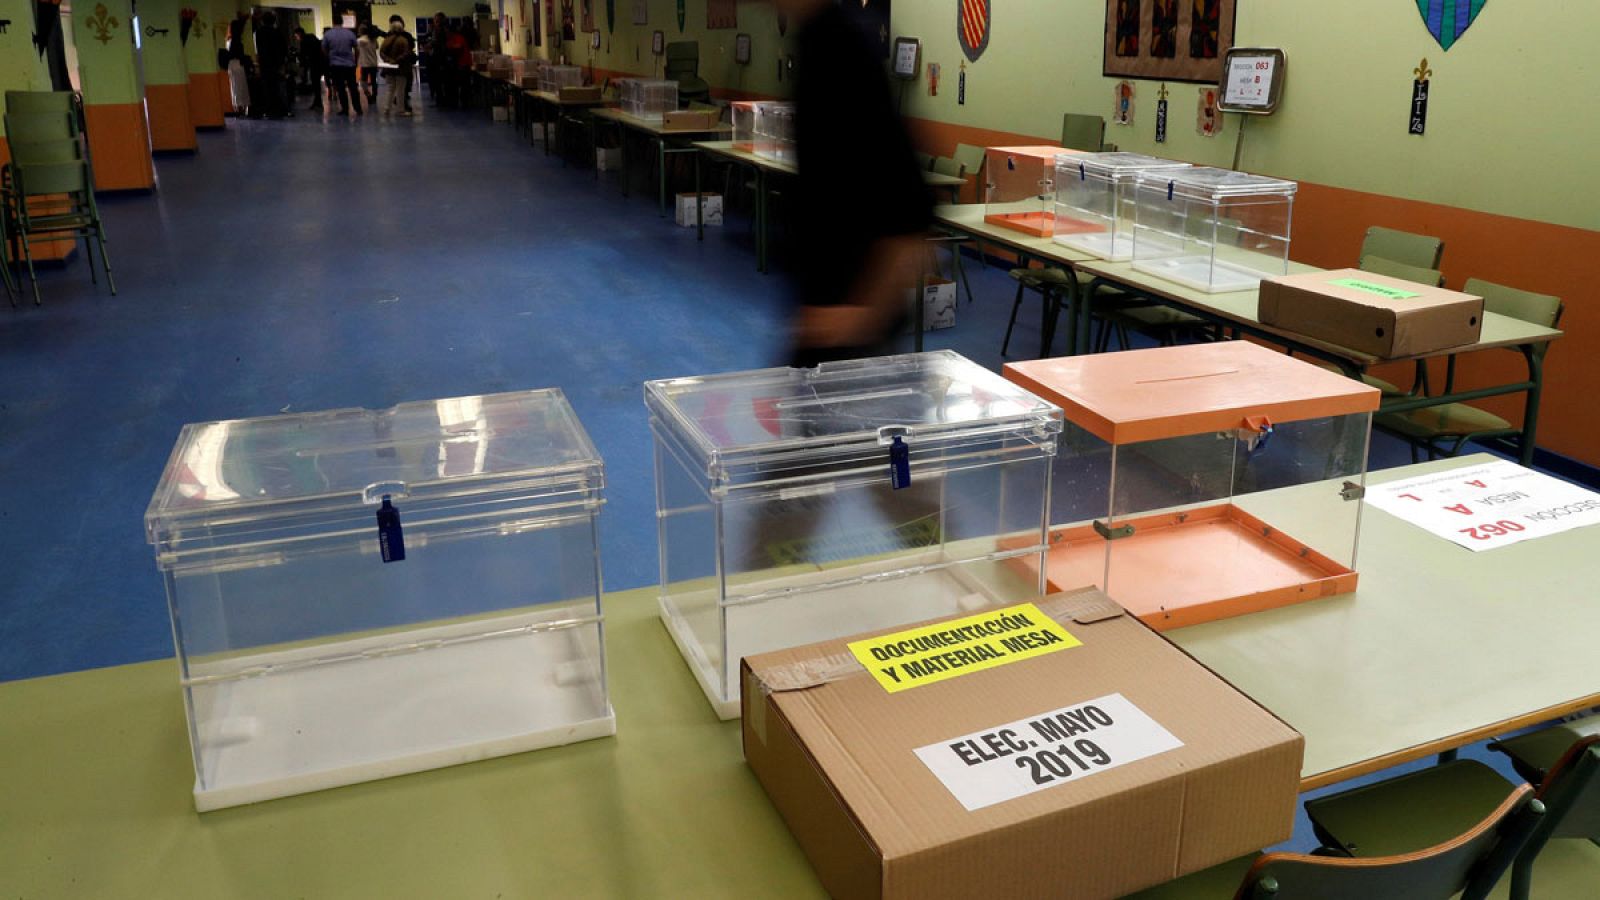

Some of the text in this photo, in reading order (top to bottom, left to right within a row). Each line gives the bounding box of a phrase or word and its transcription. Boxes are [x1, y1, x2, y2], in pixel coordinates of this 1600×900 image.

[1255, 62, 1269, 70] 063
[1254, 75, 1261, 84] B
[1463, 479, 1488, 489] A
[1397, 493, 1424, 502] L
[1442, 490, 1530, 516] MESA A
[1458, 519, 1526, 541] 062
[869, 612, 1035, 662] DOCUMENTACIÓN
[881, 628, 1064, 684] Y MATERIAL MESA
[949, 704, 1114, 767] ELEC. MAYO
[1015, 738, 1112, 786] 2019
